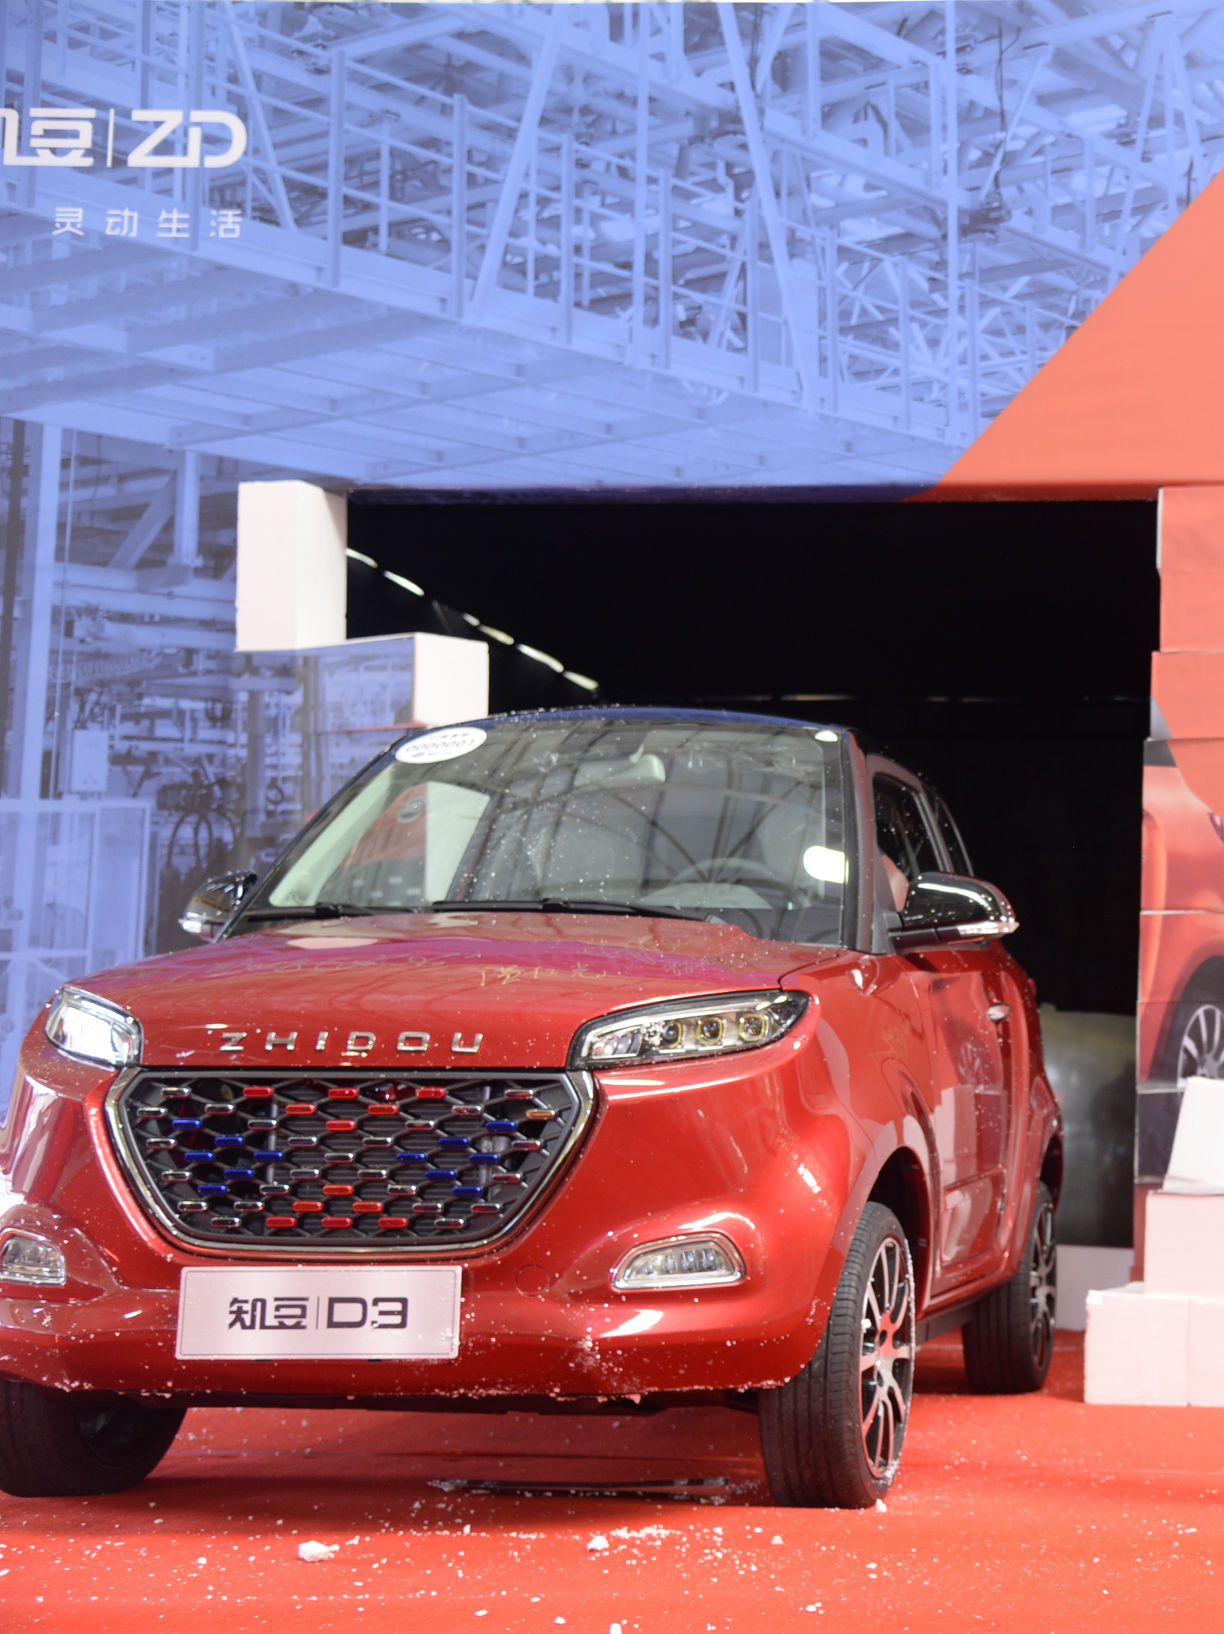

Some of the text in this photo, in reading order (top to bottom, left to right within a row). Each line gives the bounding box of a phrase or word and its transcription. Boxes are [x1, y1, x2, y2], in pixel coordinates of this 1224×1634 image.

[127, 109, 247, 168] ZD
[52, 206, 243, 239] 灵动生活
[219, 1031, 483, 1053] ZHIDOU
[228, 1296, 409, 1330] 知豆 D3
